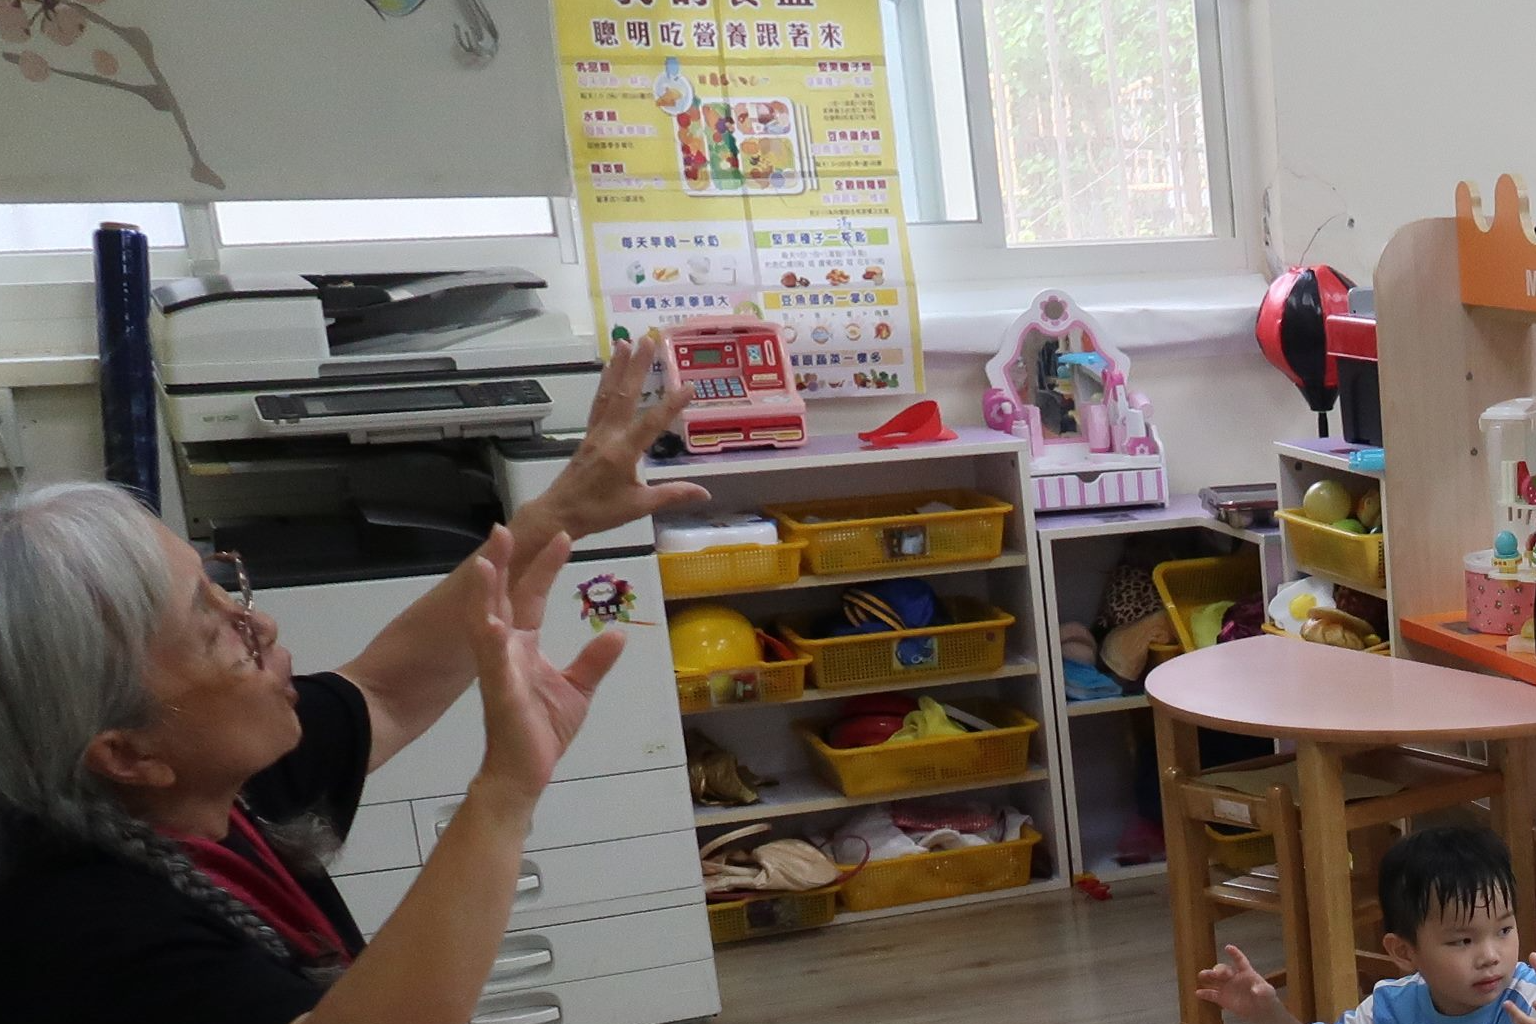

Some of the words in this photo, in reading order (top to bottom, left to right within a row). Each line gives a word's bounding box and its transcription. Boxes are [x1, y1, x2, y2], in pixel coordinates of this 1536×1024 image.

[592, 20, 843, 48] 聰明吃營養跟著來
[622, 235, 719, 248] 每天早晚一杯奶
